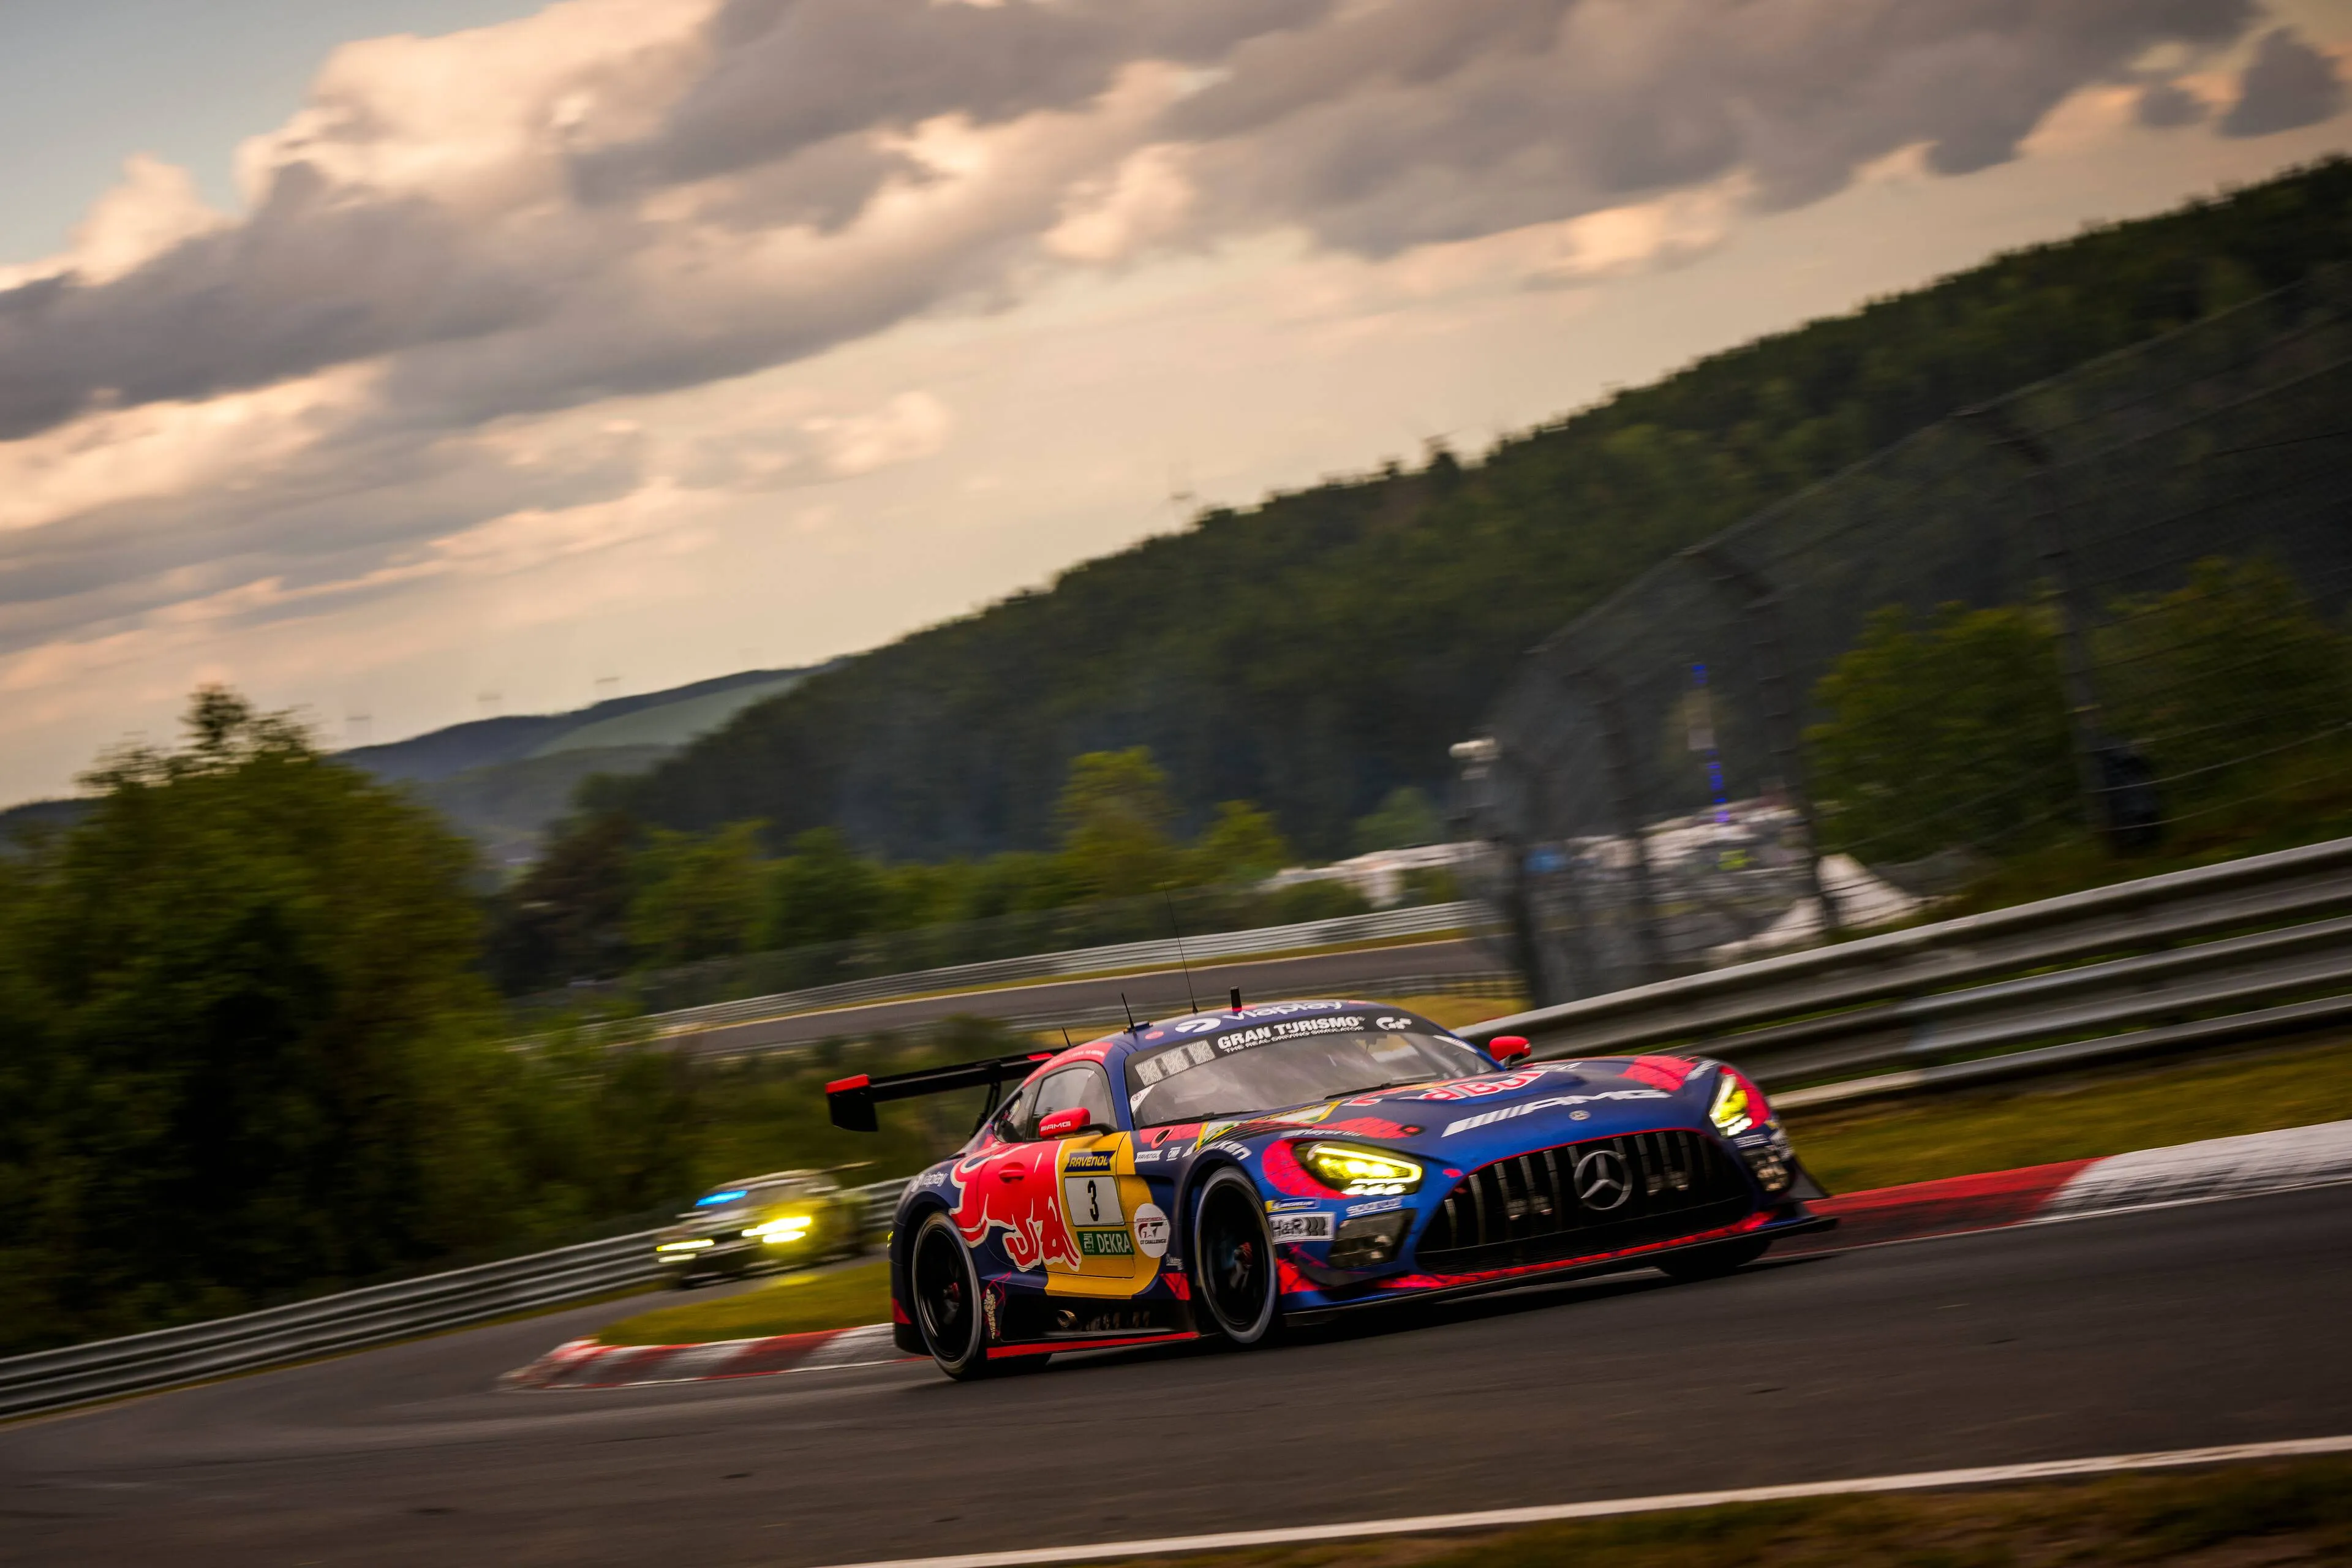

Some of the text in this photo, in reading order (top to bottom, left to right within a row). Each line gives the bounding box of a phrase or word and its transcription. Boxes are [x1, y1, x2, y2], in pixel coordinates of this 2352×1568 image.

[1218, 1027, 1272, 1049] GRAN
[1224, 1044, 1245, 1053] THE
[1245, 1038, 1270, 1047] REAL
[1047, 1121, 1071, 1129] AMG
[1069, 1155, 1109, 1167] RAVENOL
[1087, 1180, 1099, 1221] 3
[1269, 1216, 1311, 1238] H&R
[1096, 1233, 1133, 1253] DEKRA
